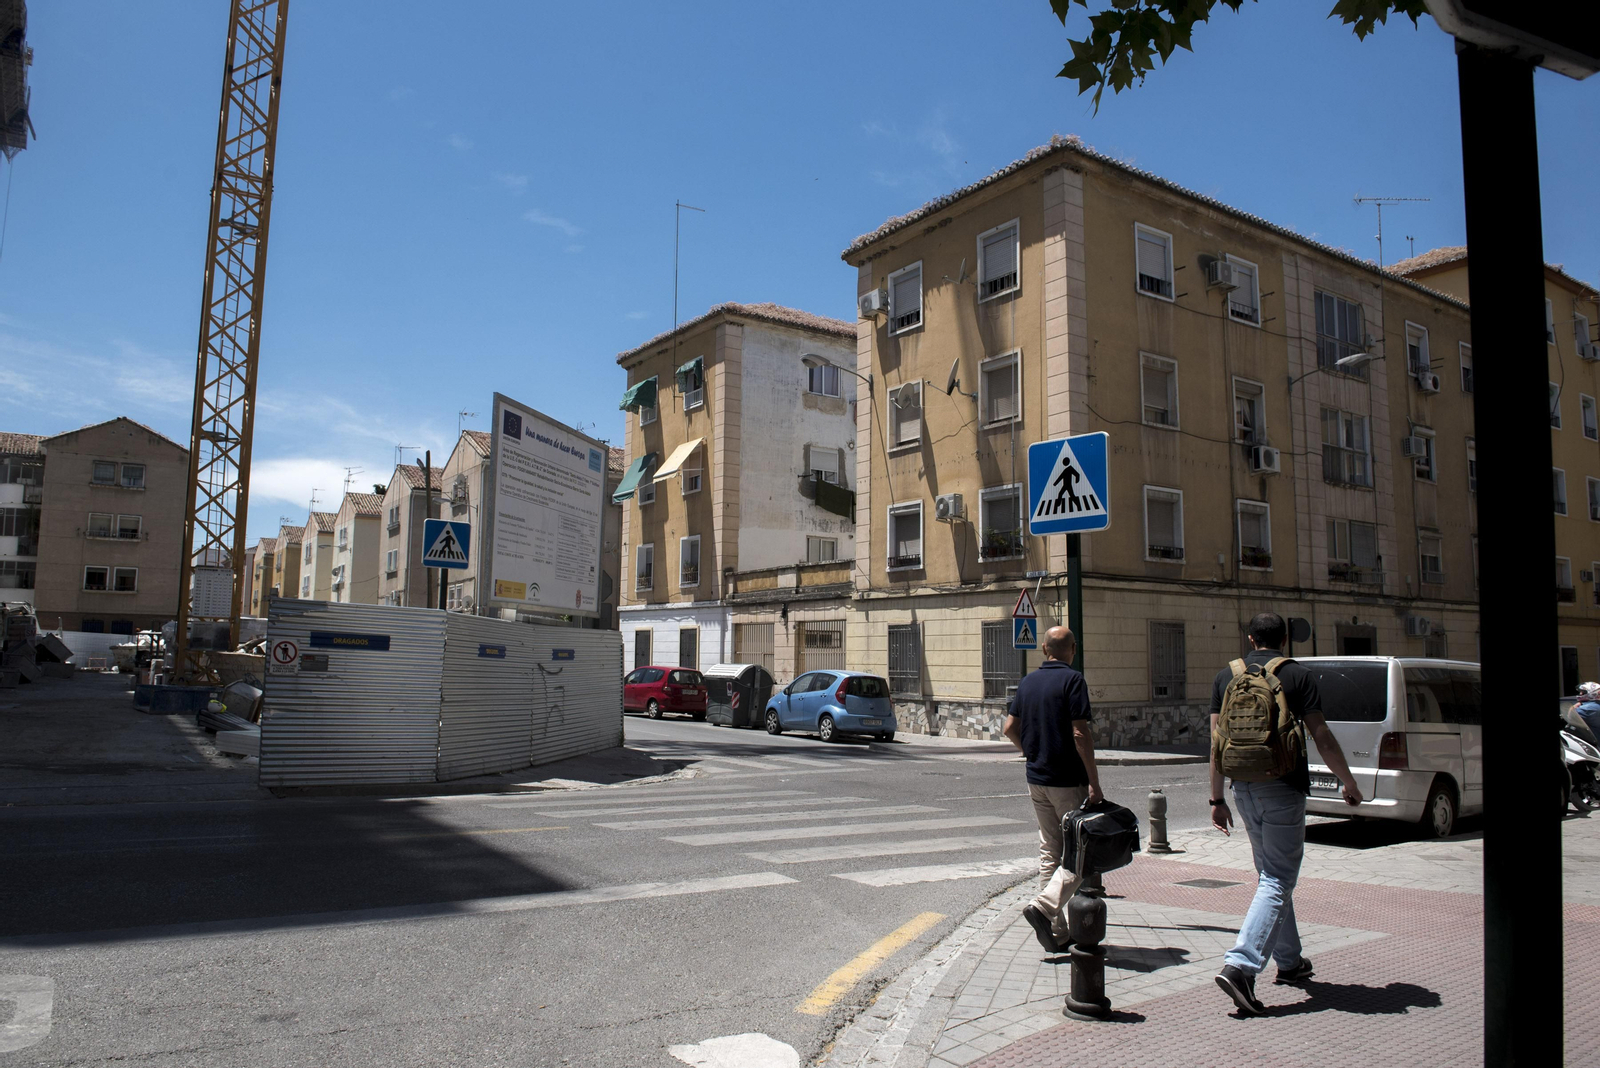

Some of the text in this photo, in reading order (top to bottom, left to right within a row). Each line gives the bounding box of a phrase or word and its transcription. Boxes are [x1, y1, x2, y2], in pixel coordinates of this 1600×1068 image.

[526, 427, 585, 462] Una manera de hacer Europa
